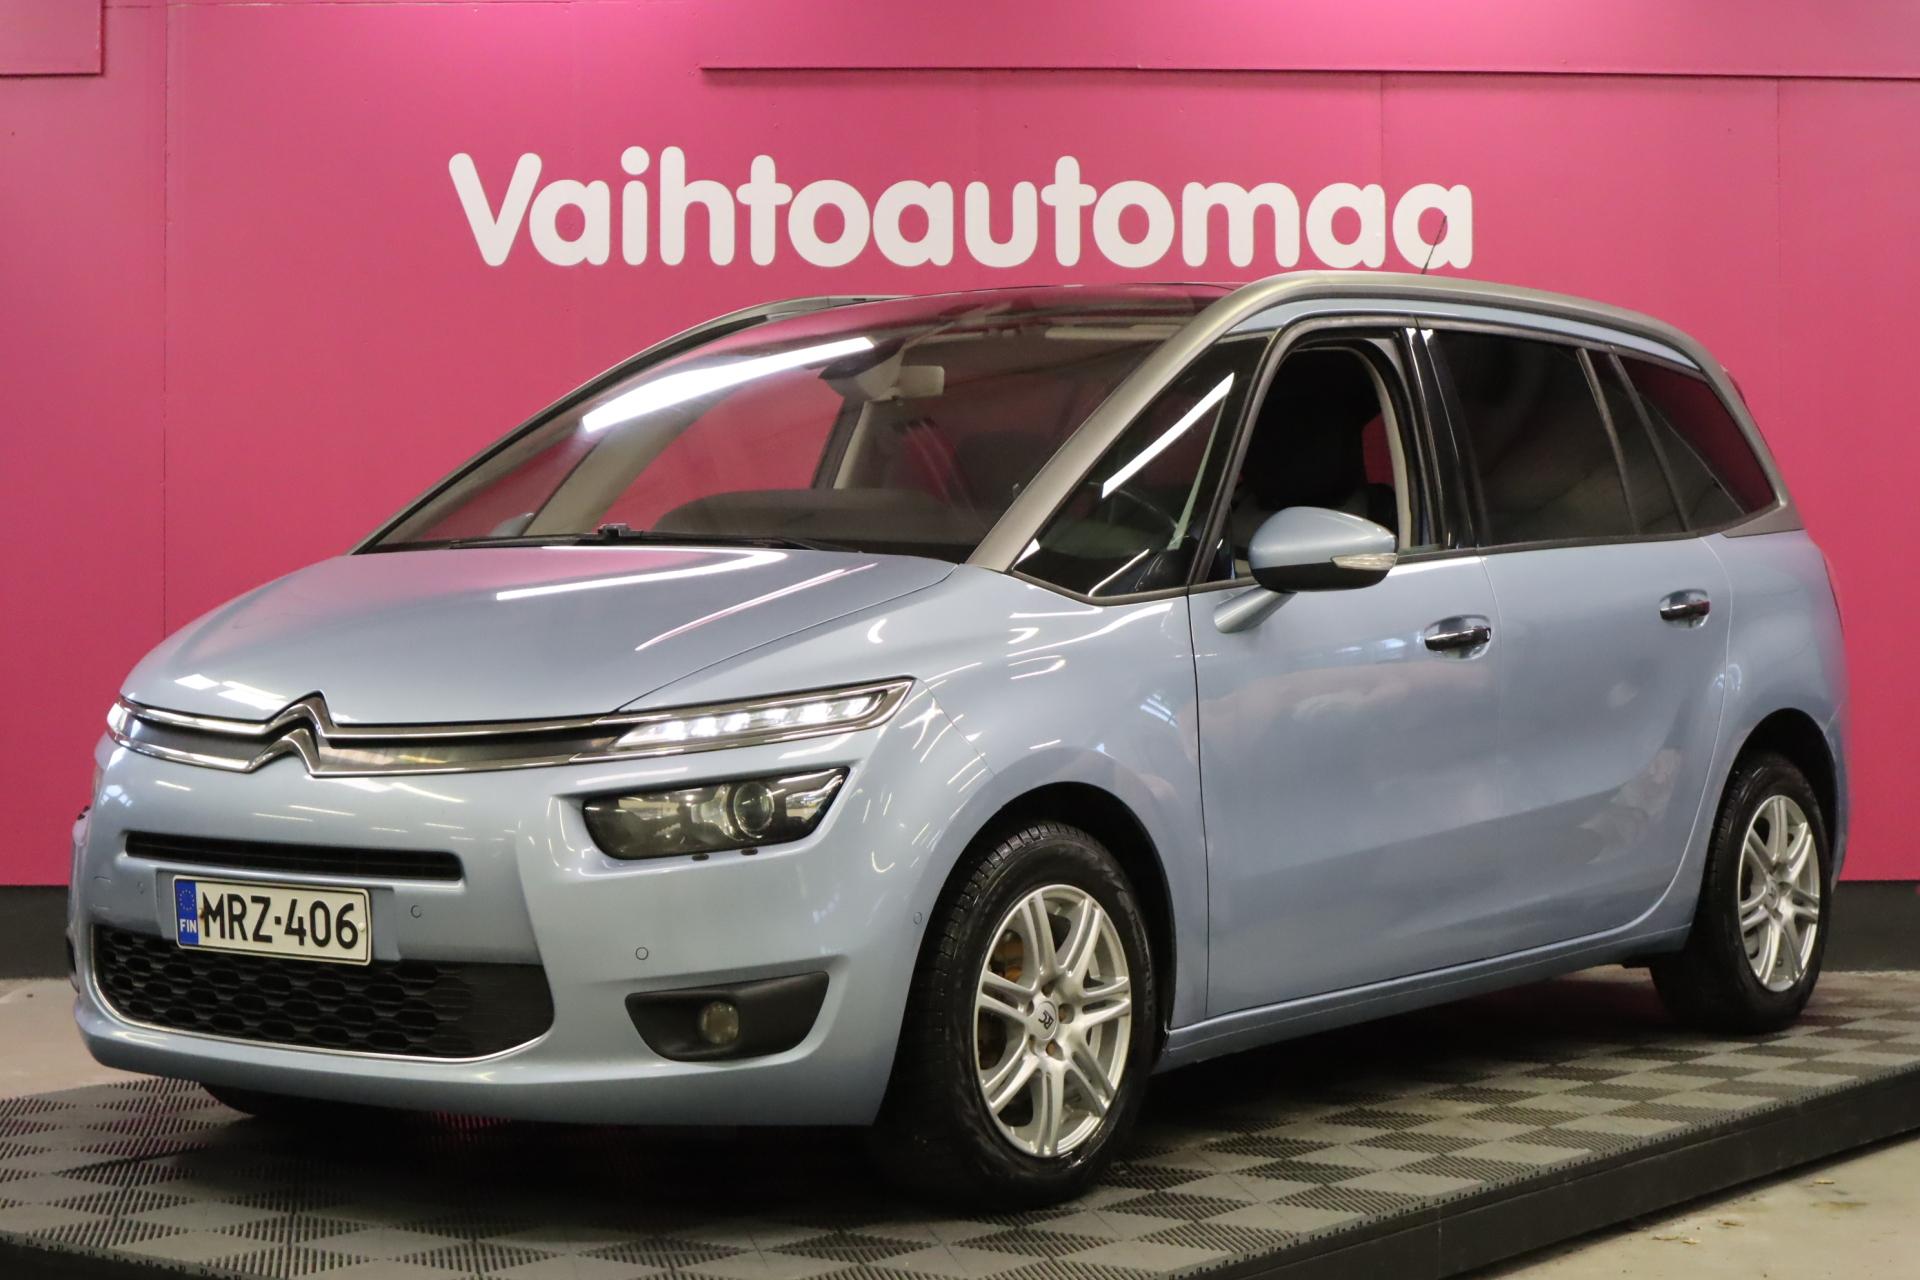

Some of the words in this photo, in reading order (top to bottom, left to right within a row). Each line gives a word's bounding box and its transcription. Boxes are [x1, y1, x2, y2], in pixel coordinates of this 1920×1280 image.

[449, 146, 1473, 269] Vaihtoautomaa
[180, 918, 198, 934] FIN
[202, 892, 358, 949] MRZ-406
